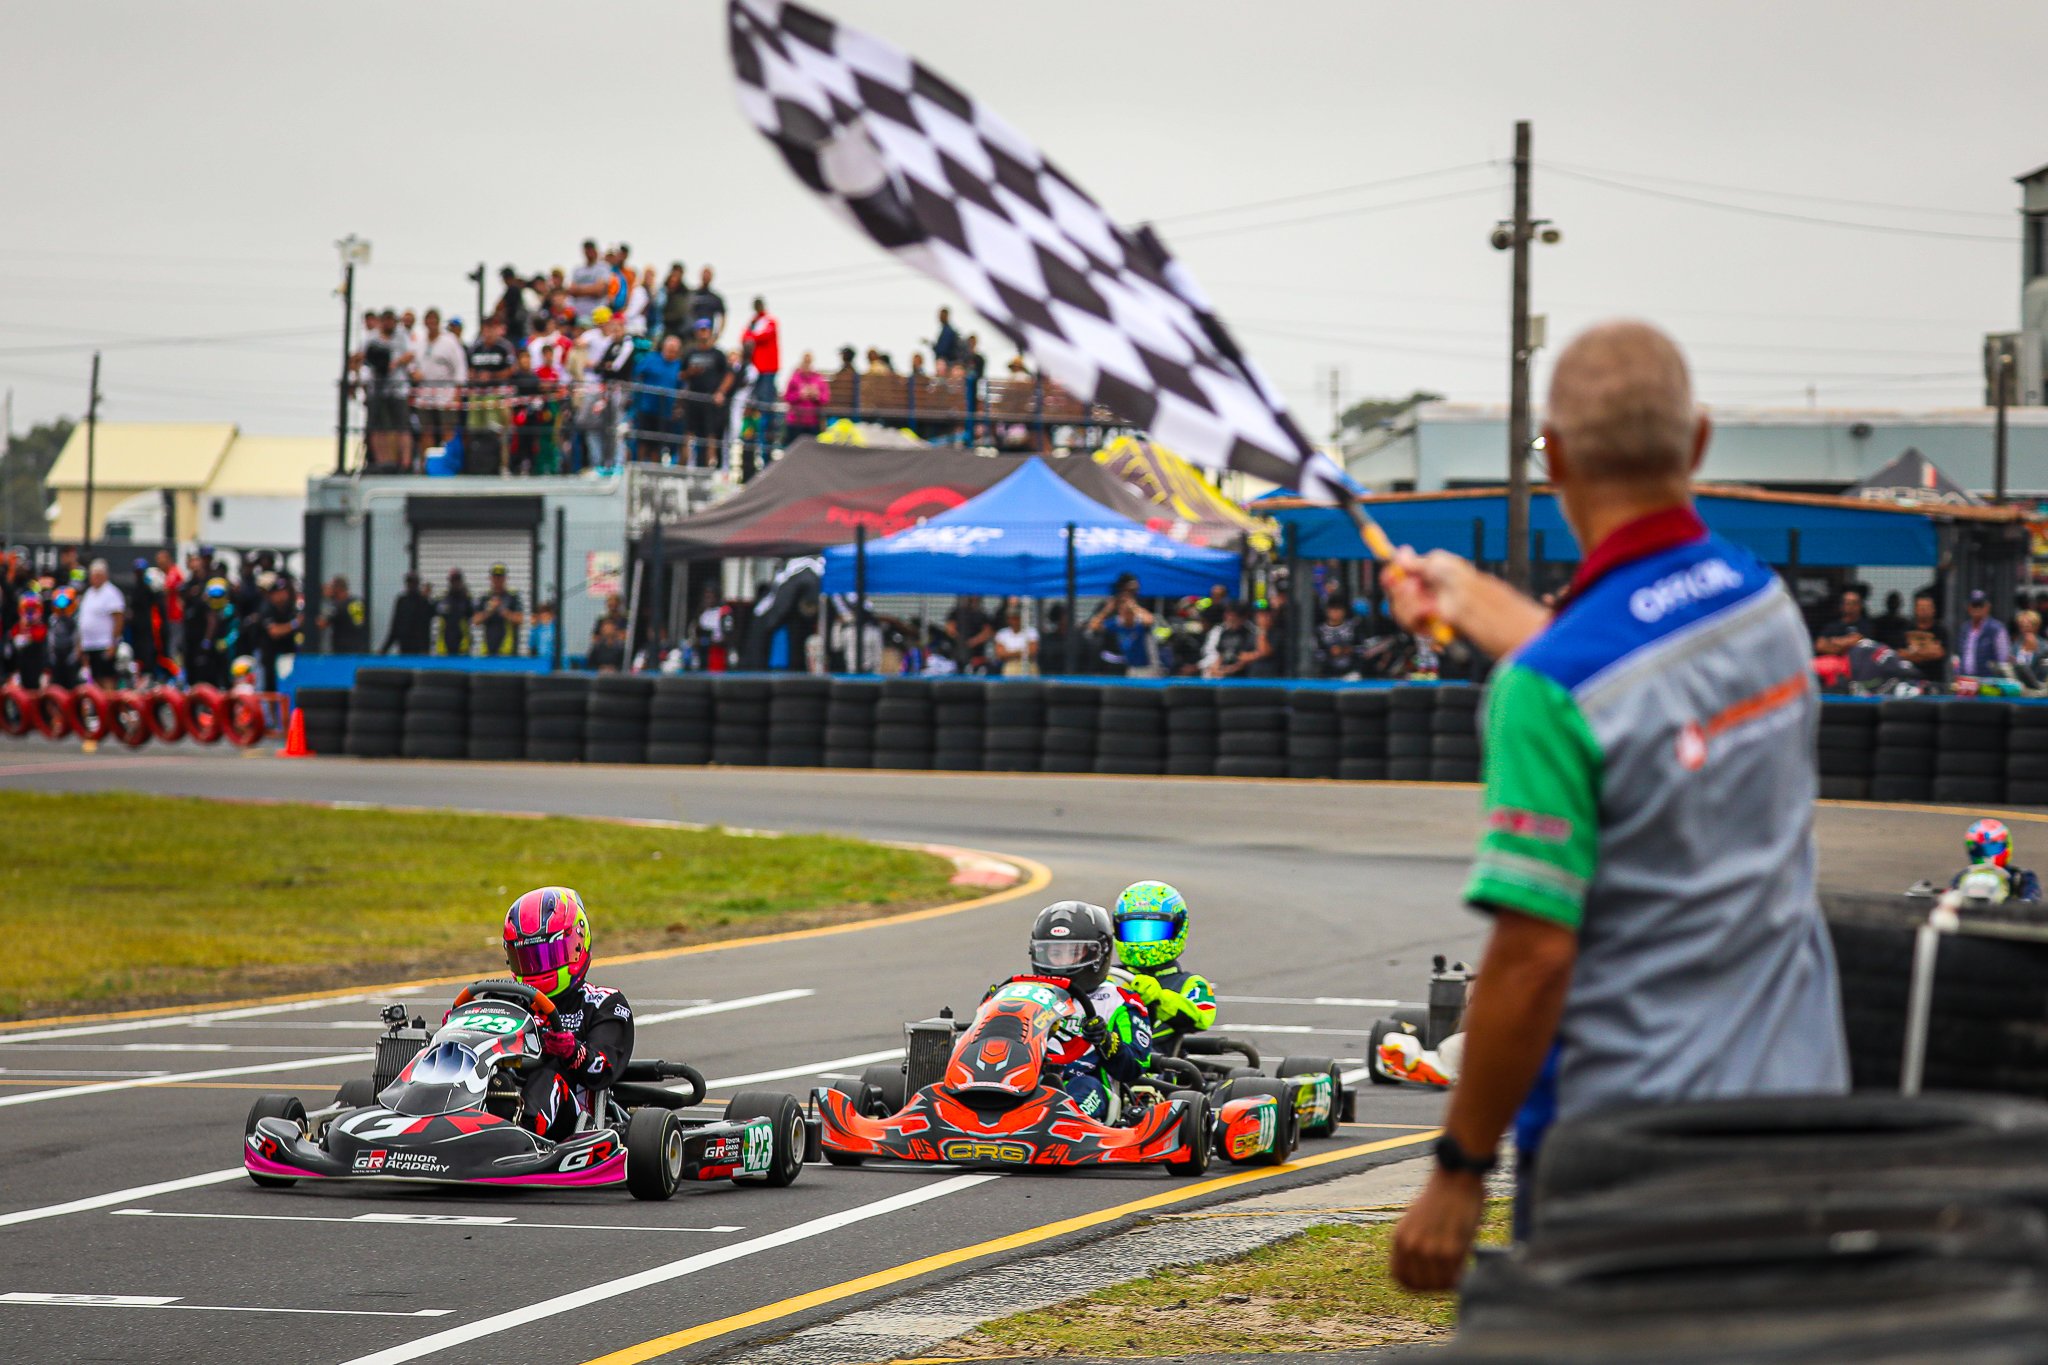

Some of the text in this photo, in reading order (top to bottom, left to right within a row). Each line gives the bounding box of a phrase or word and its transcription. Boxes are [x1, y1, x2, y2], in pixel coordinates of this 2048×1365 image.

[704, 1146, 725, 1158] GR
[748, 1126, 773, 1170] 423
[947, 1143, 1025, 1162] CRG
[354, 1152, 438, 1168] GR JUNIOR
[558, 1141, 612, 1173] GR
[385, 1160, 450, 1173] ACADEMY
